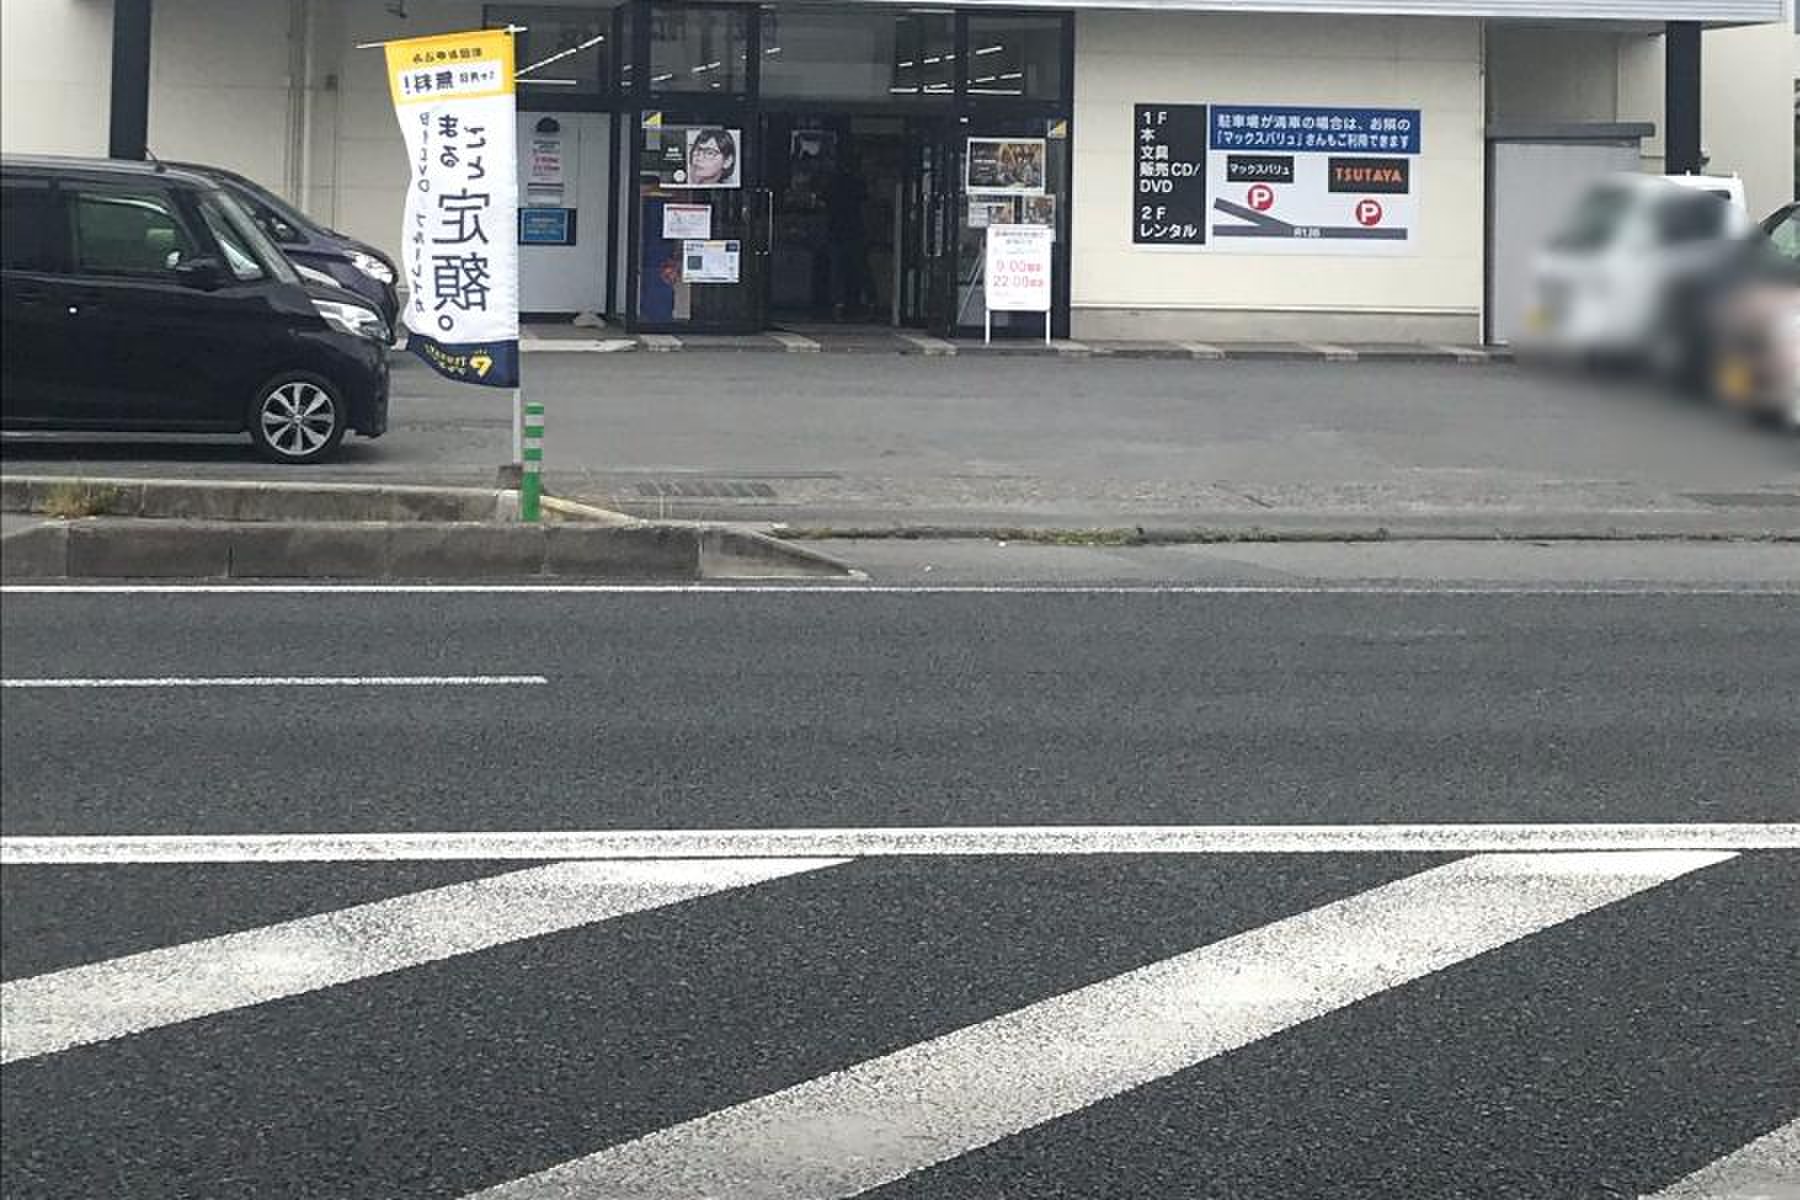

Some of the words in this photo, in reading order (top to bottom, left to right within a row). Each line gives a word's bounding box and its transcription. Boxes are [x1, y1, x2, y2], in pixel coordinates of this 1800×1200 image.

[1140, 128, 1155, 142] 本
[1335, 167, 1402, 183] TSUTAYA
[1140, 179, 1173, 193] DVD
[1252, 189, 1271, 208] P
[1361, 203, 1379, 223] P
[1140, 223, 1198, 238] レンタル
